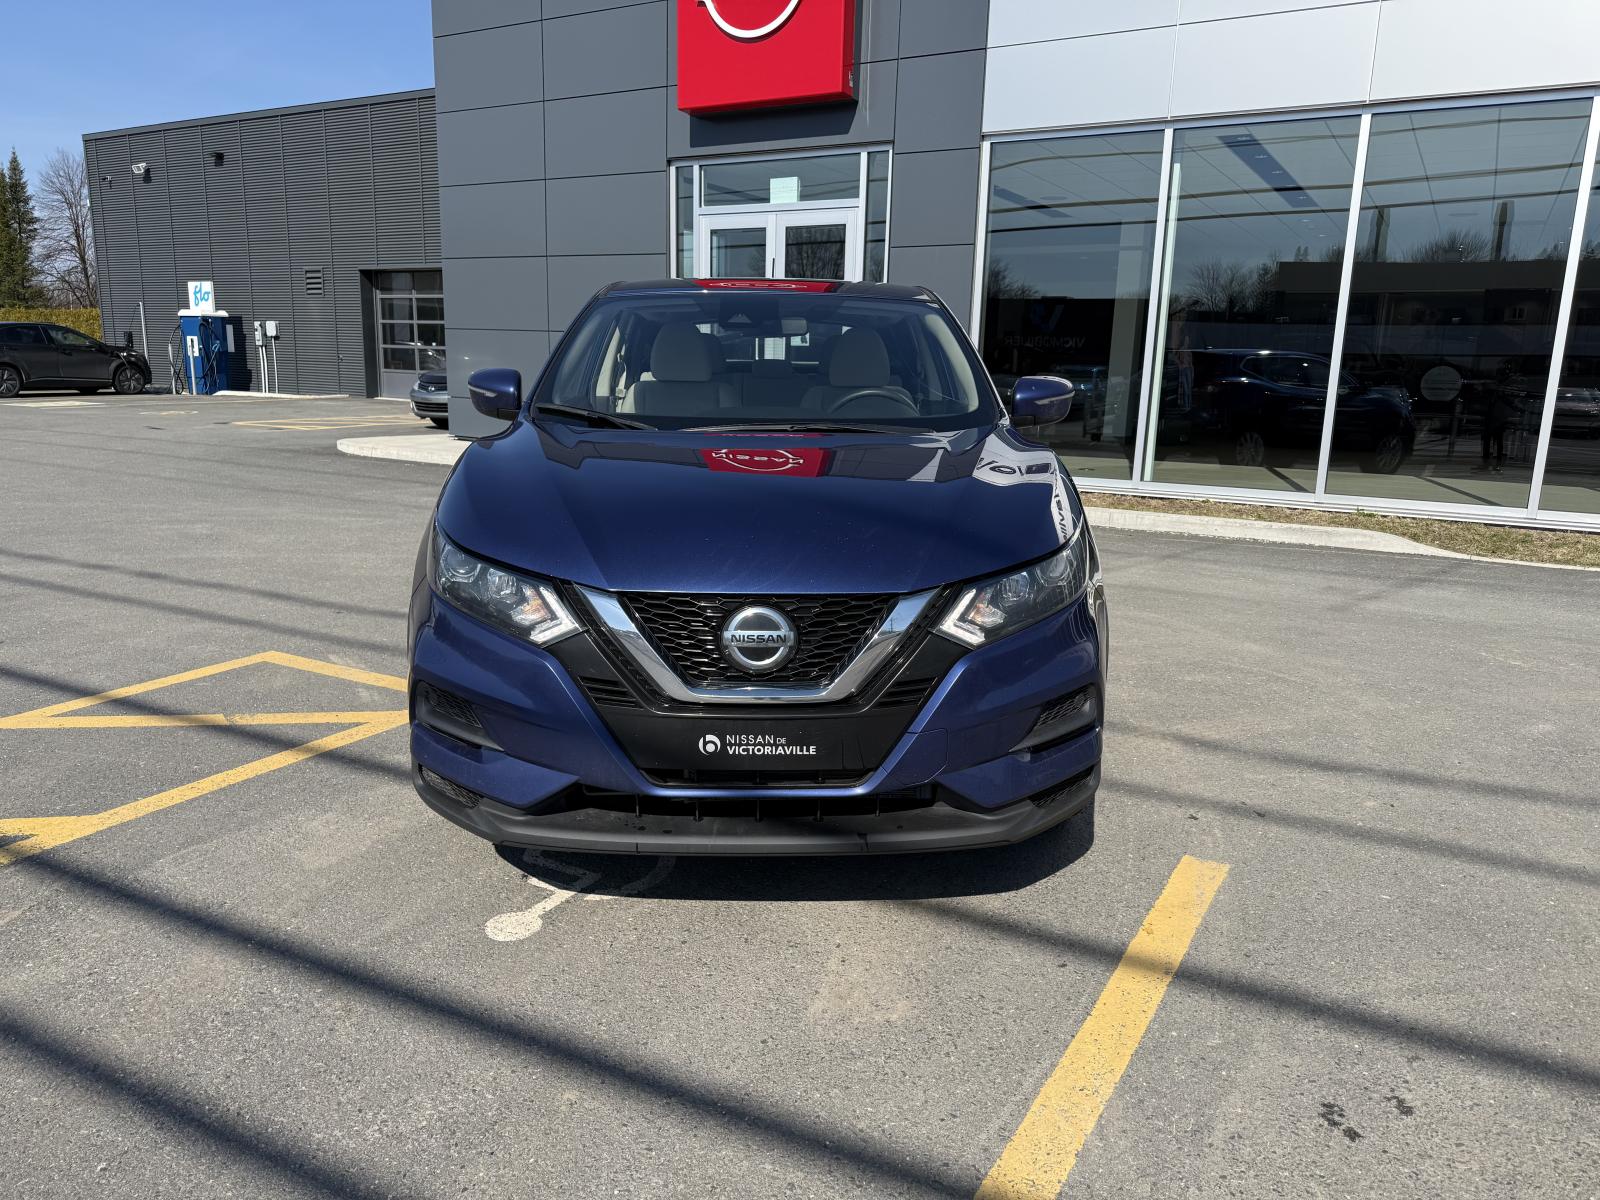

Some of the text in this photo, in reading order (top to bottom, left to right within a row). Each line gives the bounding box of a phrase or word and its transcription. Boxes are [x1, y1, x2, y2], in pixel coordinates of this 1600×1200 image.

[193, 282, 211, 306] flo
[730, 634, 787, 644] NISSAN
[726, 735, 774, 744] NISSAN
[727, 746, 817, 755] VICTORIAVILLE
